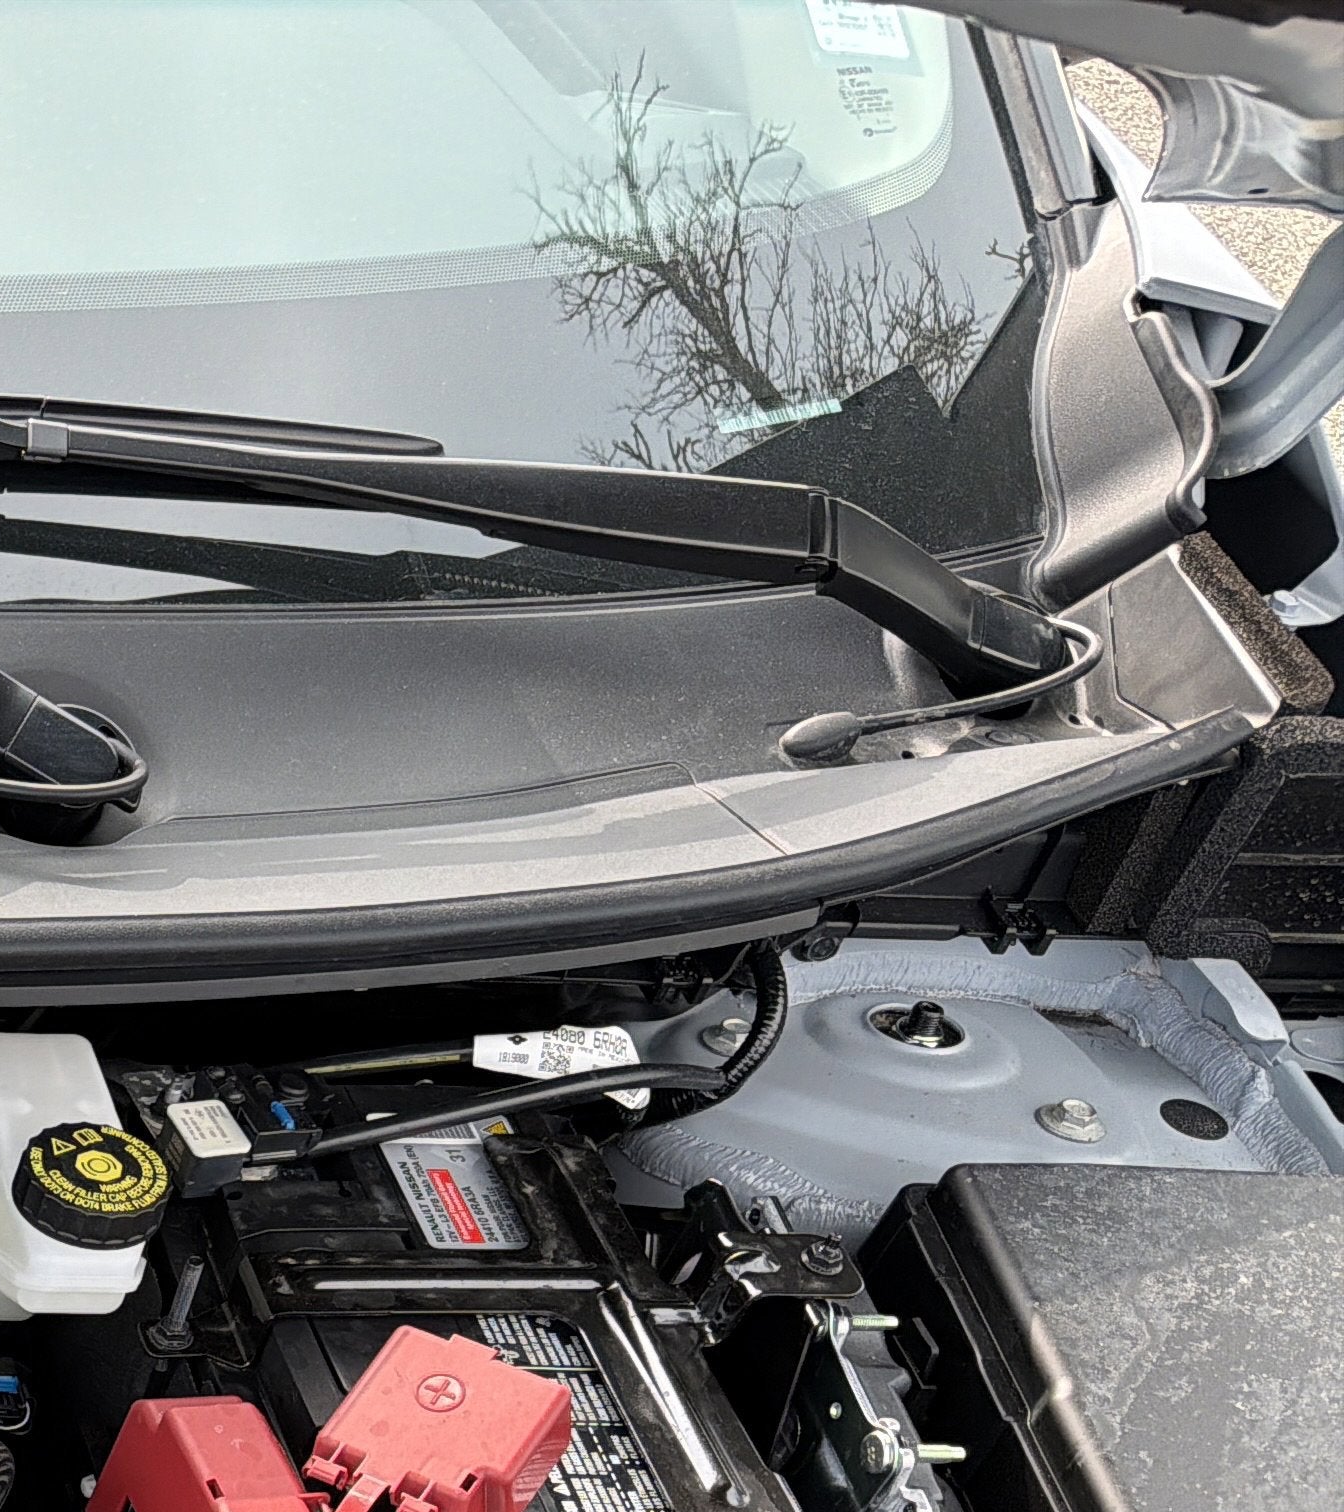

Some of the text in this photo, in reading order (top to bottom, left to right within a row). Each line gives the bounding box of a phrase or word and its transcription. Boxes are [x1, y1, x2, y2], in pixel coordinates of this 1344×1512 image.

[837, 66, 873, 76] NISSAN
[100, 1125, 151, 1152] CONTAINER
[404, 1145, 418, 1159] (EN)
[446, 1149, 465, 1162] 31
[49, 1169, 74, 1192] CLEAN
[74, 1187, 108, 1202] FILLER
[108, 1191, 128, 1202] CAP
[128, 1175, 153, 1199] BEFORE
[99, 1175, 138, 1193] WARNING
[60, 1191, 75, 1203] OR
[75, 1197, 100, 1210] DOT4
[133, 1193, 156, 1209] FLUID
[397, 1161, 446, 1242] RENAULT NISSAN
[101, 1200, 135, 1212] BRAKE
[477, 1217, 498, 1242] 24410
